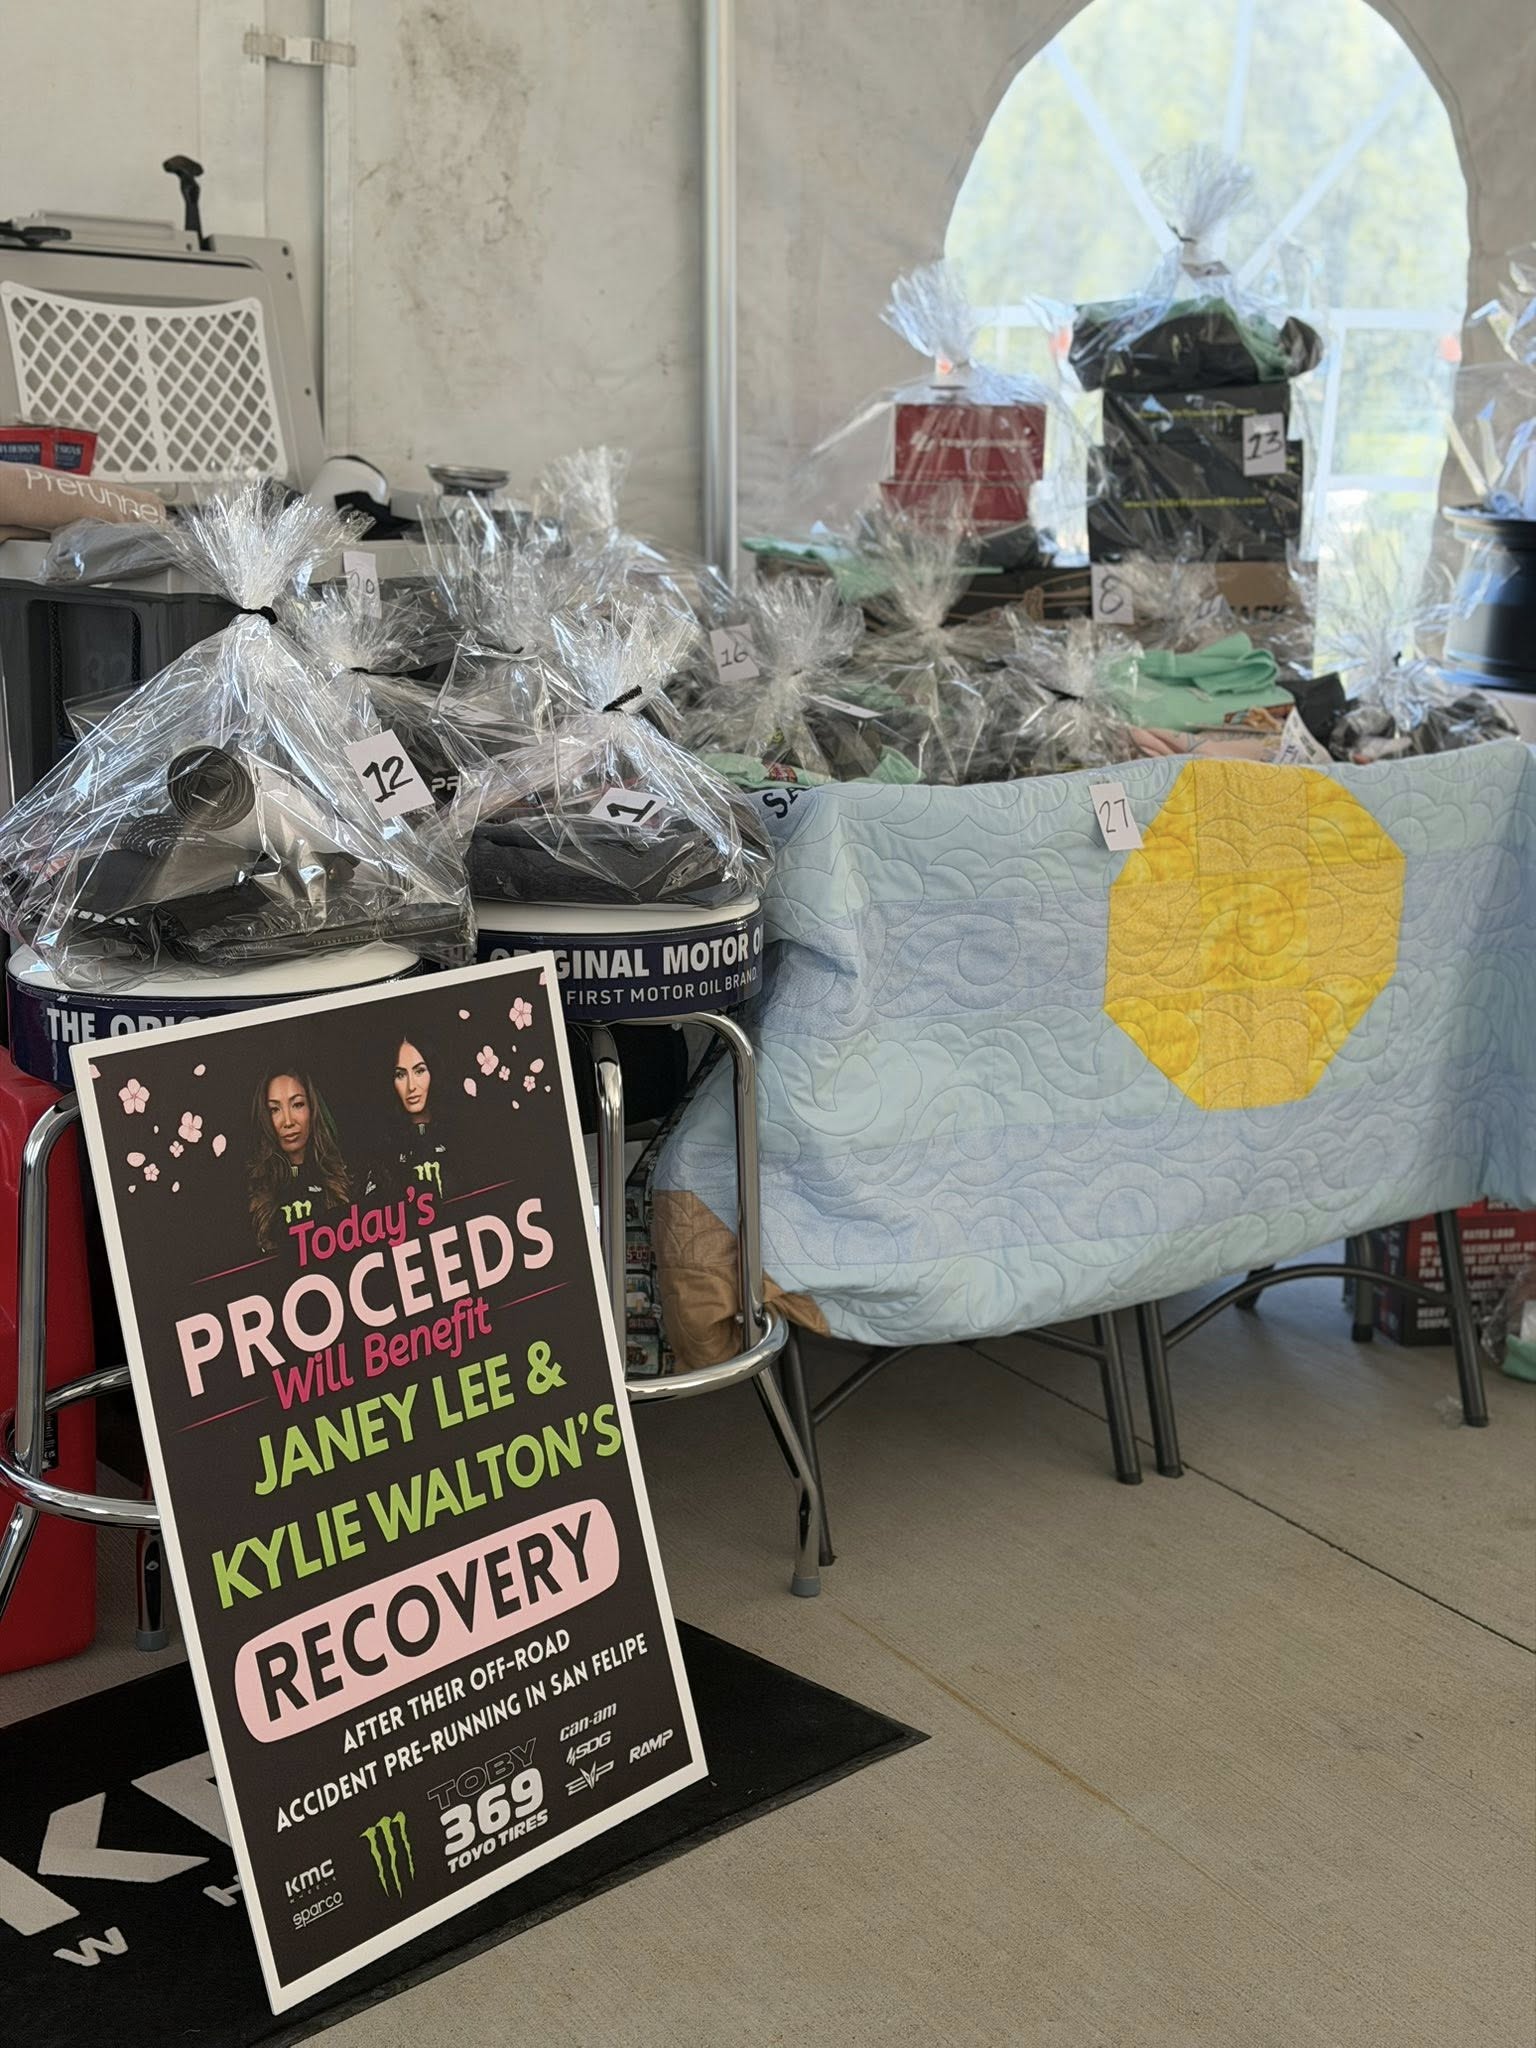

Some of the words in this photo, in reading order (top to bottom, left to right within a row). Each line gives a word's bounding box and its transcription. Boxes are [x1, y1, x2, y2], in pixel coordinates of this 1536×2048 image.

[720, 642, 748, 668] 16
[361, 755, 414, 803] 12
[609, 799, 656, 823] 1
[1099, 798, 1129, 833] 27
[663, 932, 749, 976] MOTOR
[46, 1007, 97, 1043] THE
[566, 989, 624, 1005] FIRST
[630, 983, 695, 1003] MOTOR
[699, 979, 722, 997] OIL
[289, 1186, 436, 1267] Today's
[175, 1197, 555, 1397] PROCEEDS
[272, 1343, 353, 1409] Will
[363, 1297, 492, 1378] Benefit
[255, 1384, 418, 1496] JANEY
[432, 1353, 515, 1430] LEE
[526, 1340, 568, 1395] &
[211, 1499, 366, 1609] KYLIE
[366, 1404, 622, 1543] WALTON'S
[254, 1510, 592, 1723] RECOVERY
[343, 1705, 405, 1754] AFTER
[407, 1677, 466, 1721] THEIR
[469, 1629, 571, 1691] OFF-ROAD
[277, 1760, 378, 1833] ACCIDENT
[384, 1693, 521, 1778] PRE-RUNNING
[525, 1680, 547, 1708] IN
[550, 1661, 589, 1696] SAN
[591, 1632, 648, 1677] FELIPE
[629, 1728, 674, 1764] RAMP
[427, 1737, 537, 1811] TOBY
[439, 1767, 544, 1856] 369
[447, 1837, 496, 1874] TOYO
[498, 1808, 549, 1846] TIRES
[293, 1891, 343, 1928] sparco
